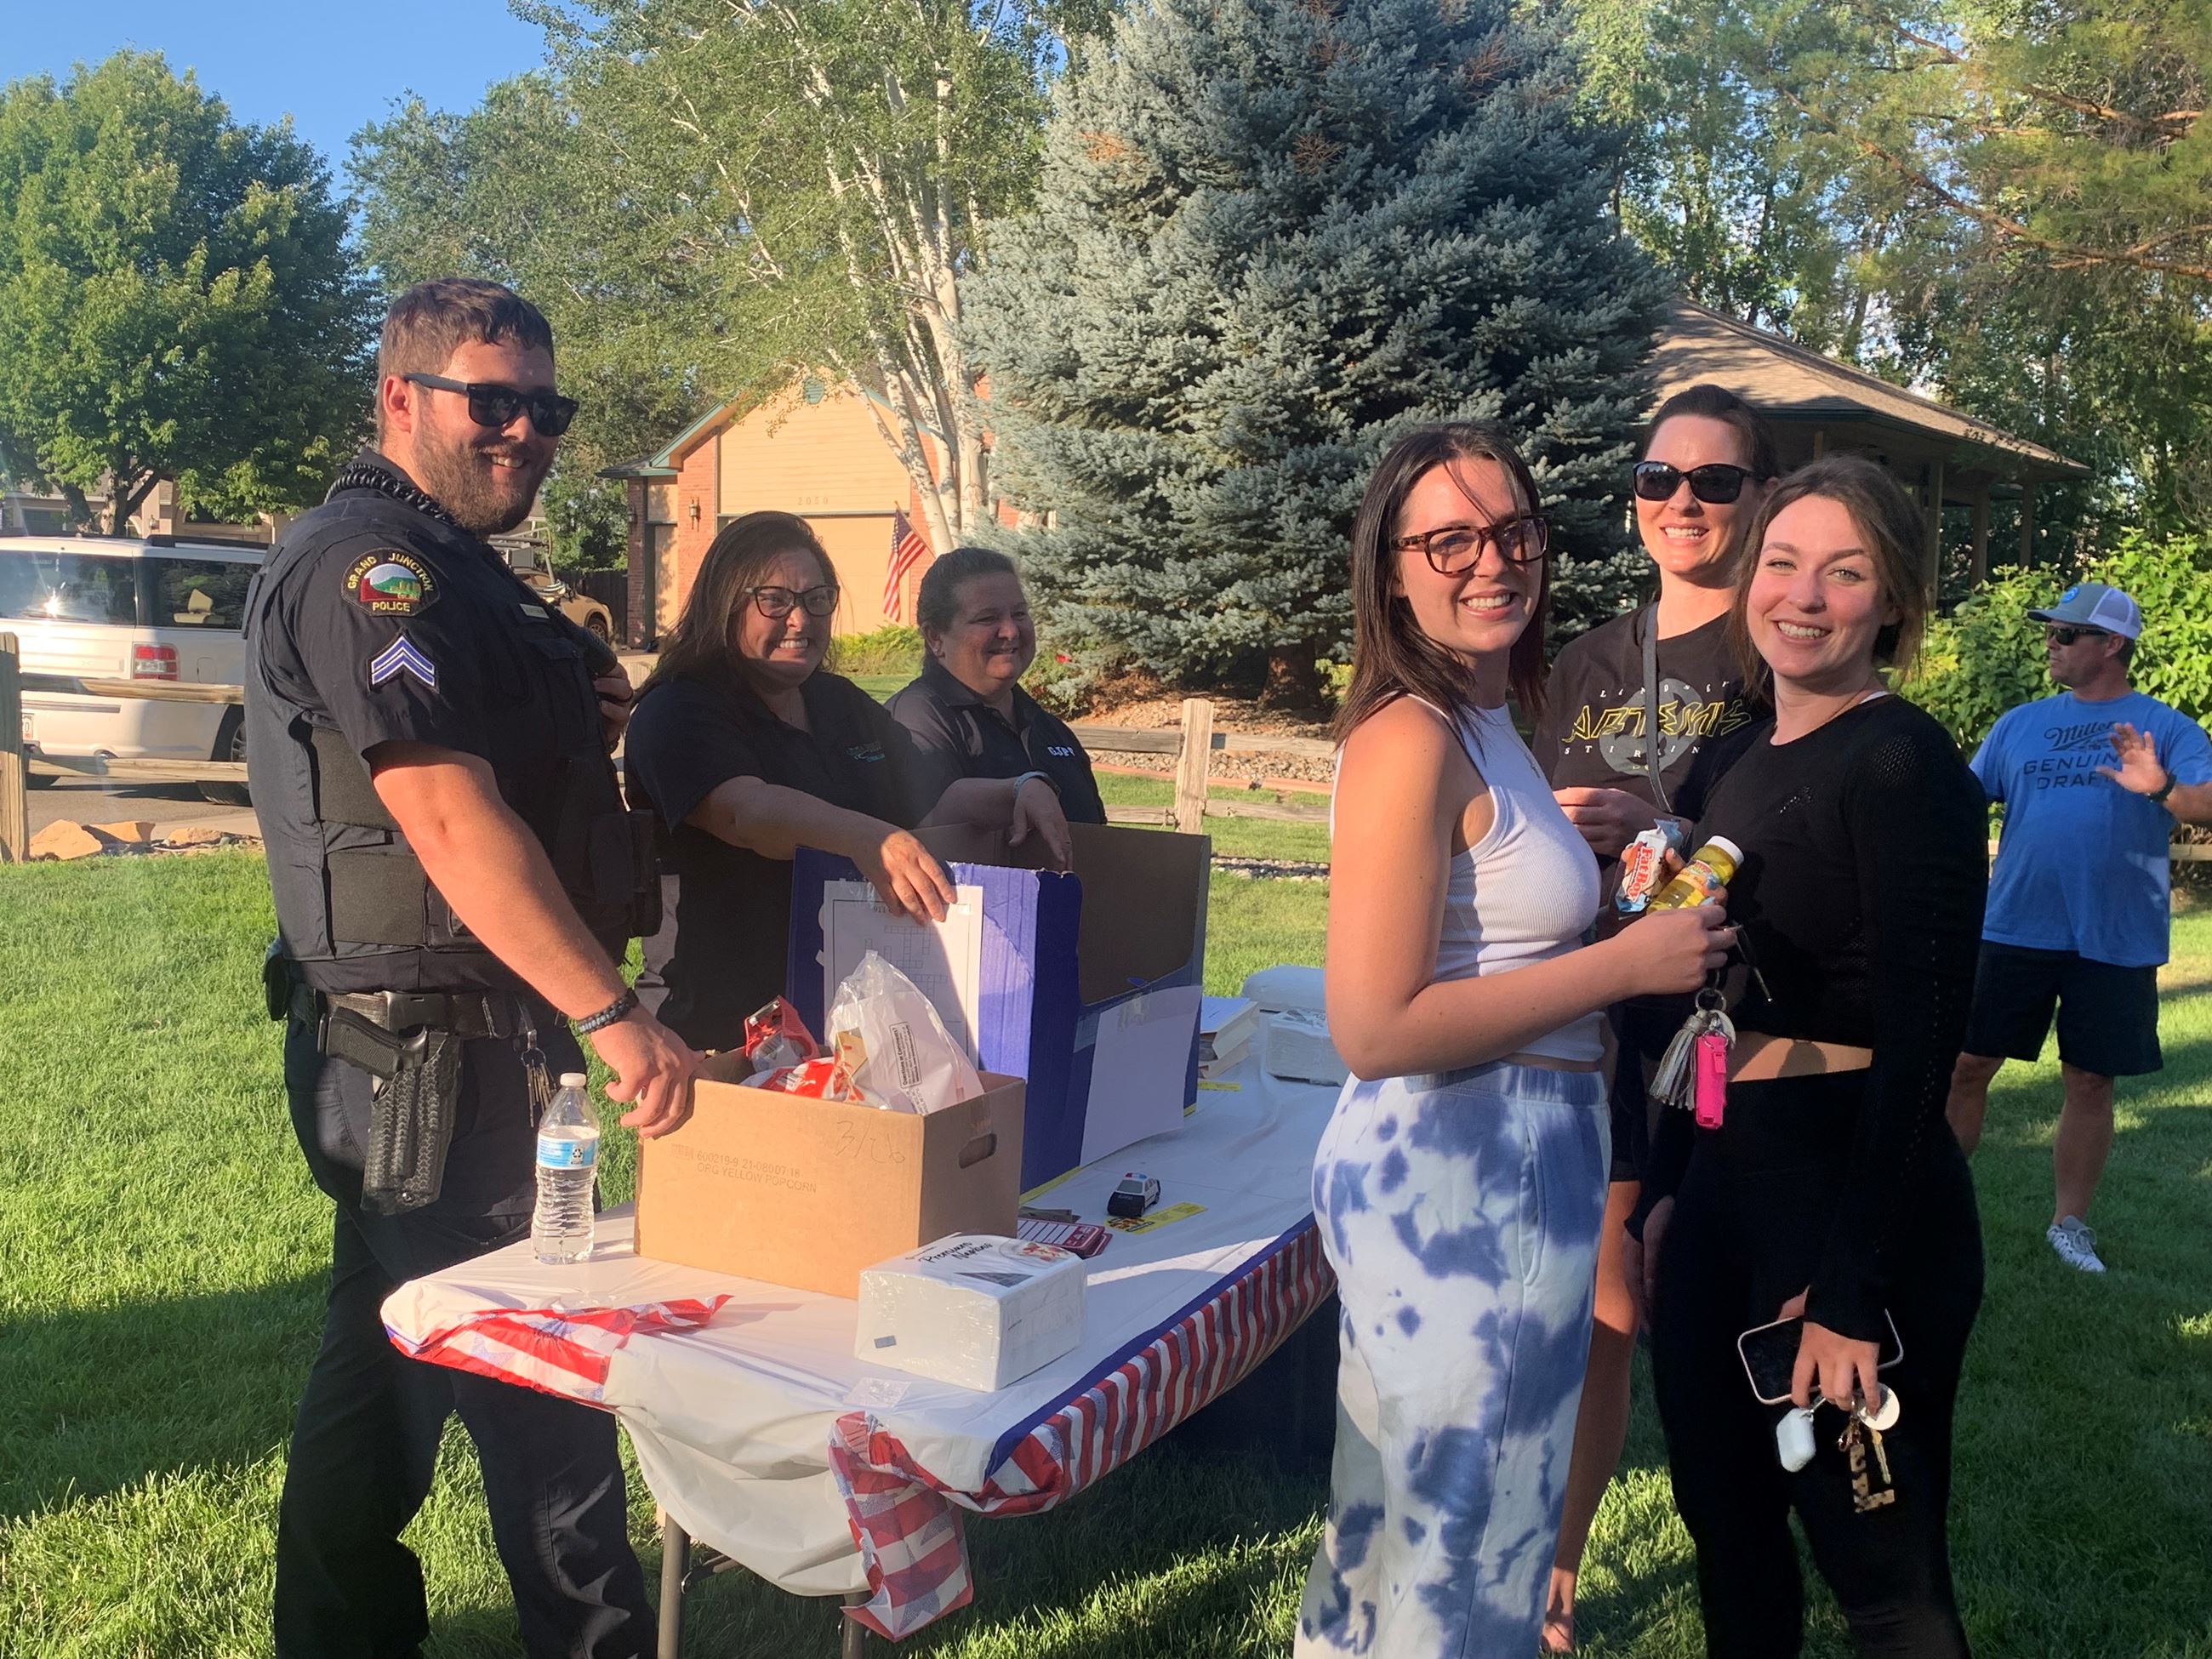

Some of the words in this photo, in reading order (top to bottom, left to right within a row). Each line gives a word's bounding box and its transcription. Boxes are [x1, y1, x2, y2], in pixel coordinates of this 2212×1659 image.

[347, 556, 378, 589] GRAND
[388, 553, 434, 591] JUNCTION
[372, 601, 411, 613] POLICE
[2044, 721, 2118, 747] Miller
[1564, 744, 1701, 758] STIRLIN
[2023, 752, 2119, 775] GENUIN
[2037, 771, 2109, 790] DRAF
[892, 1027, 903, 1056] Comments?
[900, 1062, 909, 1086] Questions
[697, 1162, 720, 1175] ORG
[721, 1166, 764, 1183] YELLOW
[766, 1174, 818, 1193] POPCORN
[918, 1241, 973, 1263] Premium
[951, 1242, 994, 1260] Napkins
